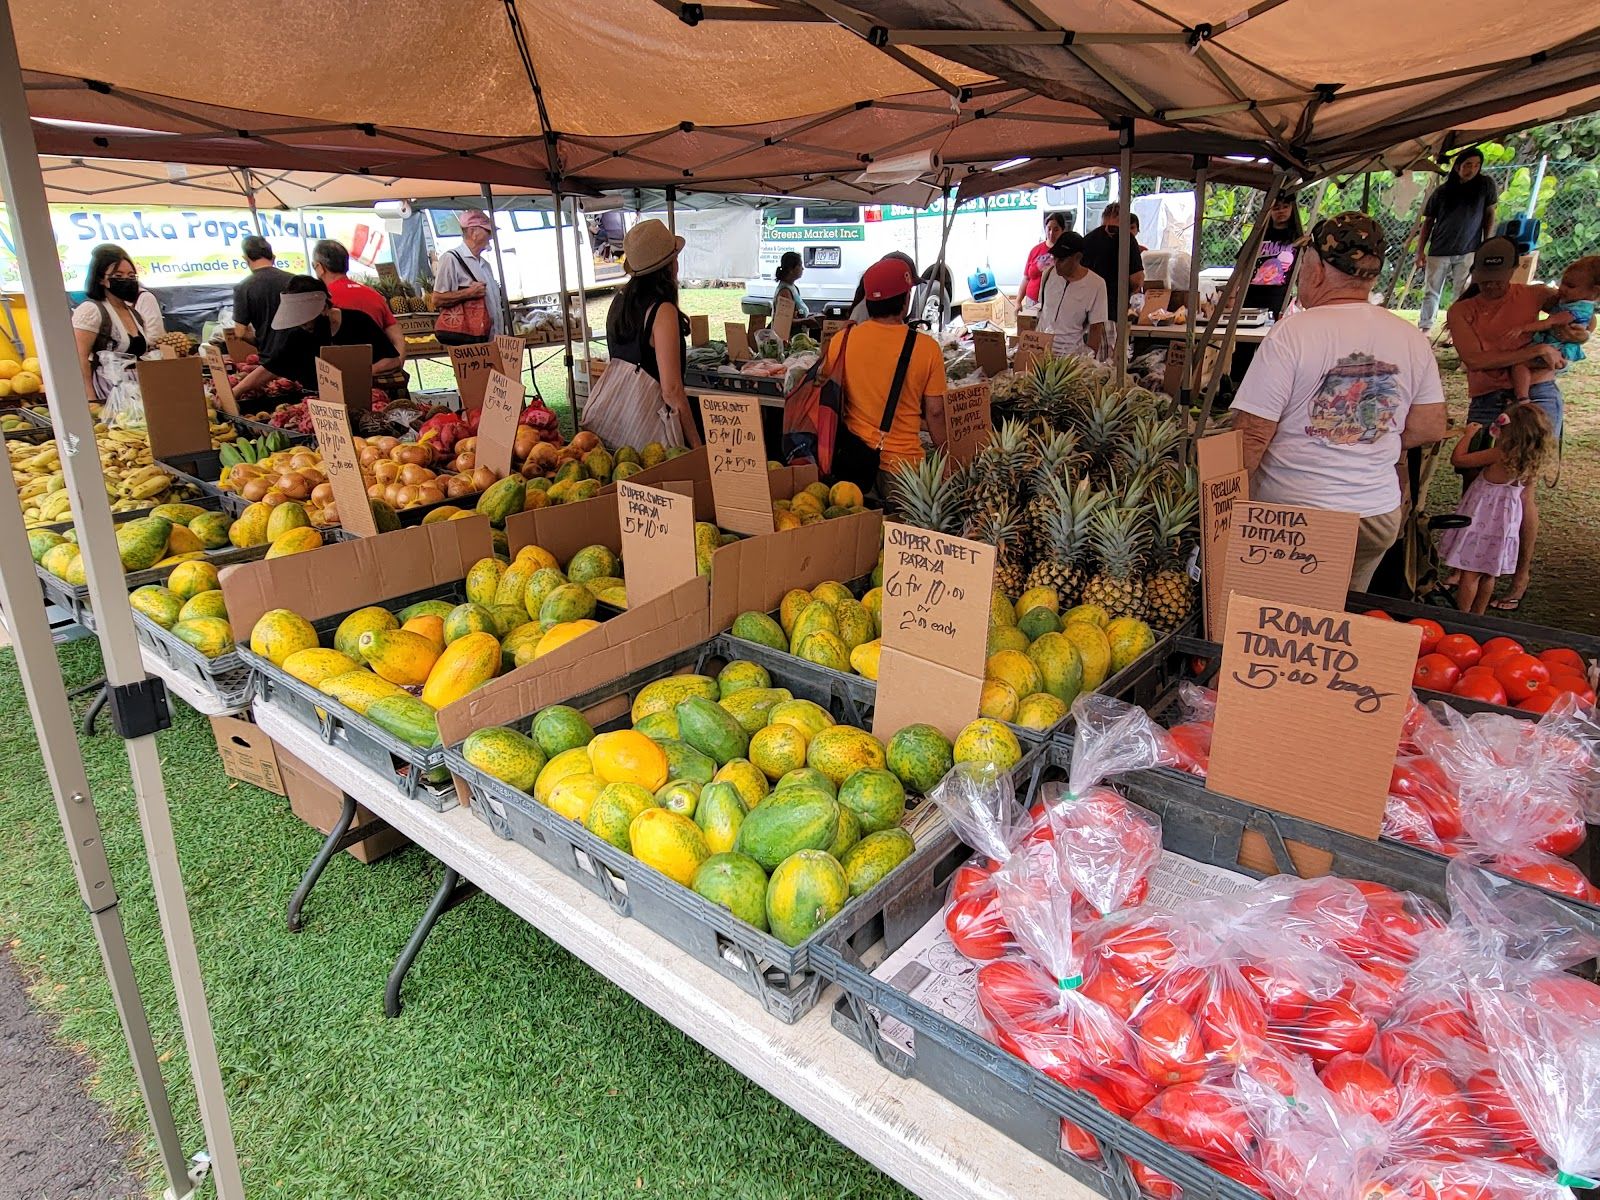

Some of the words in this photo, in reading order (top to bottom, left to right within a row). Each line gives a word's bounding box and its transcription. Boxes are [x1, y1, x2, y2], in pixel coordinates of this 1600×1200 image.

[978, 190, 1039, 209] Marke
[70, 212, 178, 240] Shaka
[181, 212, 250, 246] Pops
[258, 213, 327, 239] Maui
[771, 230, 802, 239] Greens
[803, 229, 838, 239] Market
[840, 229, 859, 238] Inc.
[151, 257, 229, 274] Handmade
[233, 259, 289, 271] Poles
[454, 346, 490, 359] SHALLOT
[967, 386, 989, 399] SWEET
[310, 403, 329, 418] SUPER
[329, 406, 345, 421] SWEET
[703, 399, 729, 412] SUPER
[728, 402, 750, 413] SWEET
[315, 417, 341, 434] PAPAYA
[709, 413, 742, 426] PAPAYA
[708, 429, 718, 444] 5
[714, 454, 723, 475] 2
[620, 484, 646, 502] SUPER
[645, 492, 675, 509] SWEET
[1210, 476, 1241, 501] REGULAR
[628, 501, 660, 521] PAPAYA
[1213, 496, 1238, 516] TOMAT
[624, 516, 635, 533] 5
[1248, 507, 1308, 527] ROMA
[1238, 524, 1306, 546] TOMATO
[888, 528, 932, 553] SUPER
[934, 539, 982, 564] SWEET
[898, 551, 944, 575] PAPAYA
[1240, 545, 1286, 564] 5.00
[1288, 547, 1327, 574] bag
[886, 570, 902, 597] 6
[905, 574, 922, 597] for
[925, 579, 965, 605] 10.00
[917, 604, 931, 613] or
[900, 610, 927, 630] 2.00
[931, 621, 956, 639] each
[1259, 606, 1352, 647] ROMA
[1236, 631, 1359, 673] TOMATO
[1232, 662, 1318, 690] 5.00
[1326, 673, 1401, 713] bag
[906, 1006, 948, 1034] FRESH
[954, 1032, 998, 1062] START
